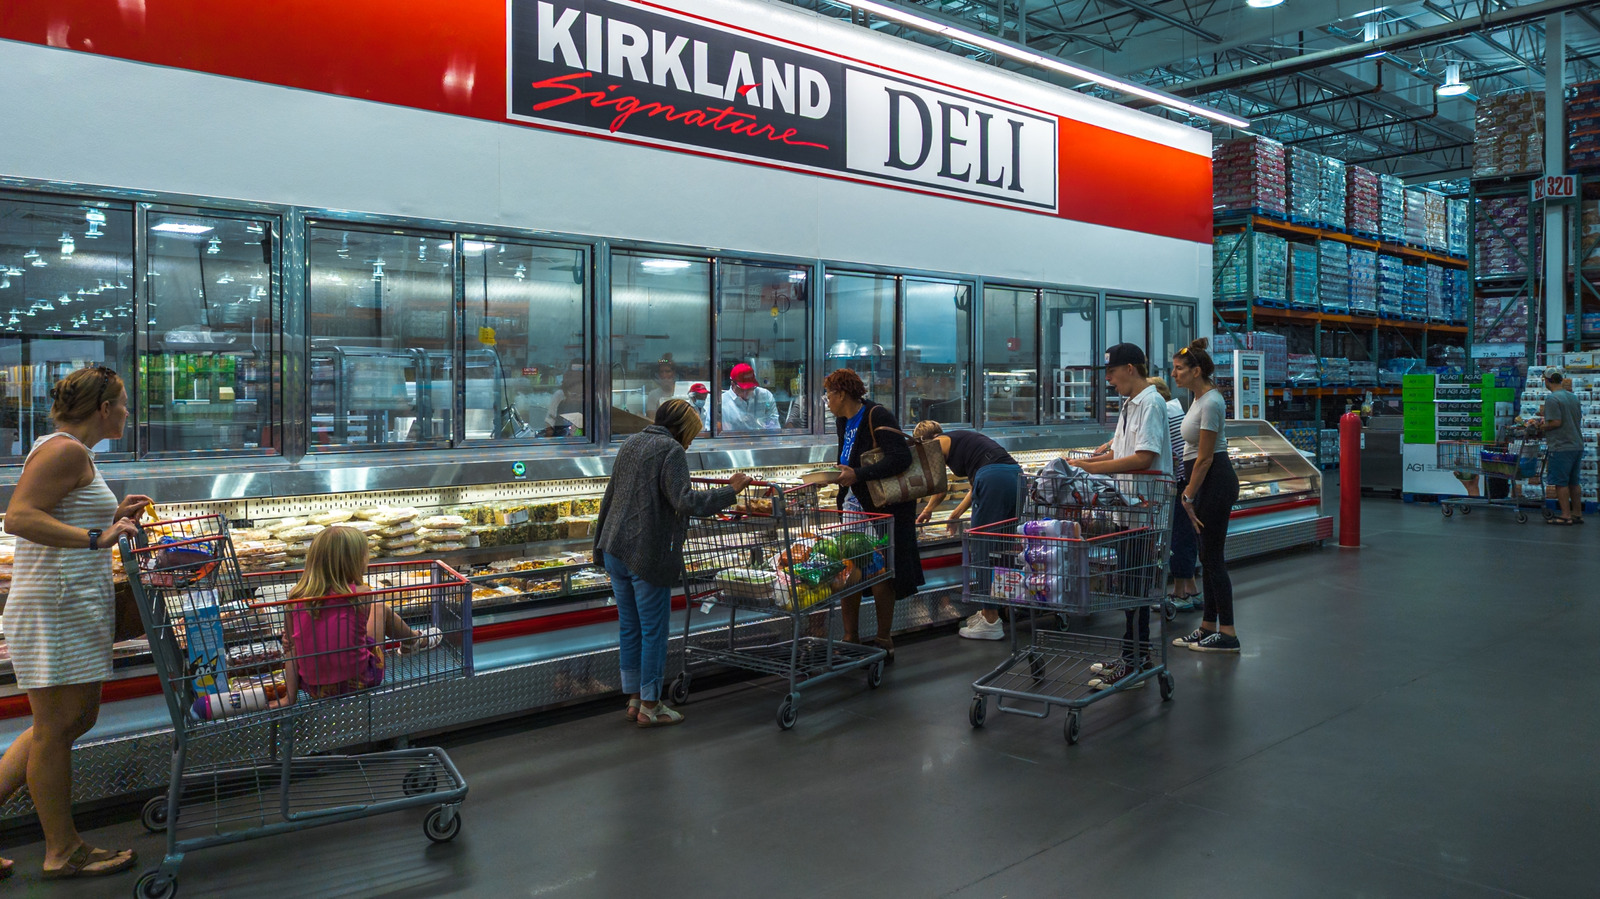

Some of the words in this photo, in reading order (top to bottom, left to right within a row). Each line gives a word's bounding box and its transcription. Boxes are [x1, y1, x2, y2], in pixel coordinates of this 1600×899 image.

[537, 1, 831, 120] KIRKLAND
[532, 71, 829, 151] Signature
[884, 86, 1025, 193] DELI
[1547, 176, 1573, 195] 320
[1406, 463, 1425, 472] AG1
